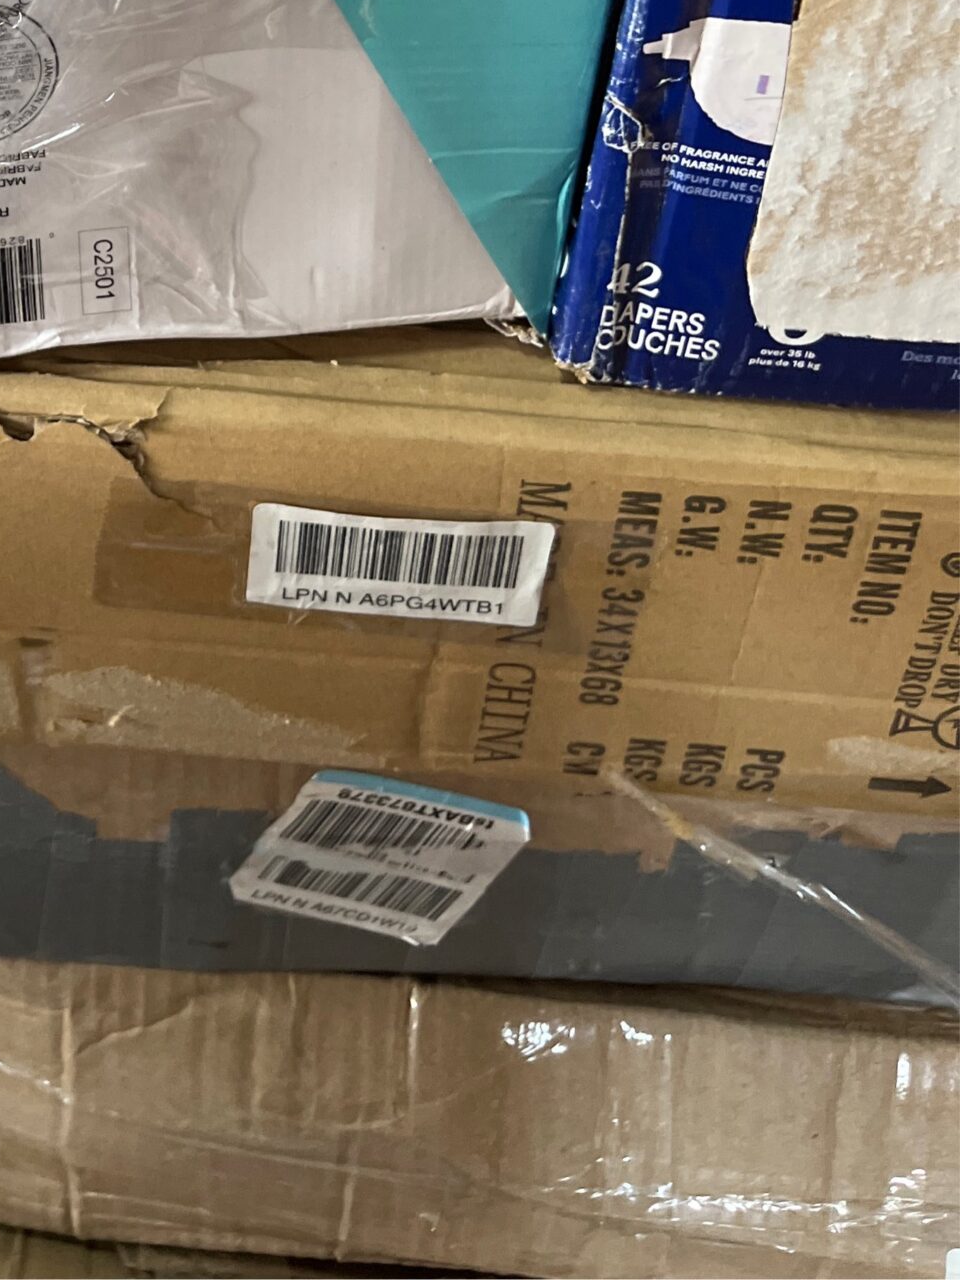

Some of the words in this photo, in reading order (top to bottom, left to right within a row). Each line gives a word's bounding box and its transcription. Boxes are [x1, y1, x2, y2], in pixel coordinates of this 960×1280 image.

[660, 153, 680, 164] NO
[680, 157, 725, 173] HARSH
[661, 141, 679, 151] OF
[679, 144, 755, 166] FRAGRANCE
[663, 167, 710, 185] PARFUM
[712, 177, 729, 187] ET
[730, 181, 748, 191] NE
[93, 238, 116, 301] C2501
[606, 261, 663, 299] 42
[596, 323, 721, 362] COUCHES
[600, 304, 706, 337] DIAPERS
[748, 357, 773, 367] plus
[775, 358, 789, 367] de
[792, 360, 805, 369] 16
[806, 360, 822, 372] kg
[759, 348, 786, 357] over
[787, 348, 803, 358] 35
[804, 350, 816, 360] lb
[900, 349, 932, 364] Des
[605, 489, 664, 577] MEAS:
[673, 493, 728, 559] G.W:
[736, 498, 794, 566] N.W:
[800, 502, 860, 564] QTY:
[864, 509, 924, 576] ITEM
[281, 586, 329, 604] LPN
[334, 590, 352, 605] N
[359, 593, 504, 616] A6PG4WTB1
[848, 580, 903, 625] NO:
[912, 590, 959, 656] DON'T
[893, 656, 938, 710] DROP
[472, 661, 538, 766] CHINA
[562, 740, 607, 777] CM
[622, 737, 667, 784] KGS
[677, 742, 727, 790] KGS
[737, 746, 787, 796] PCS
